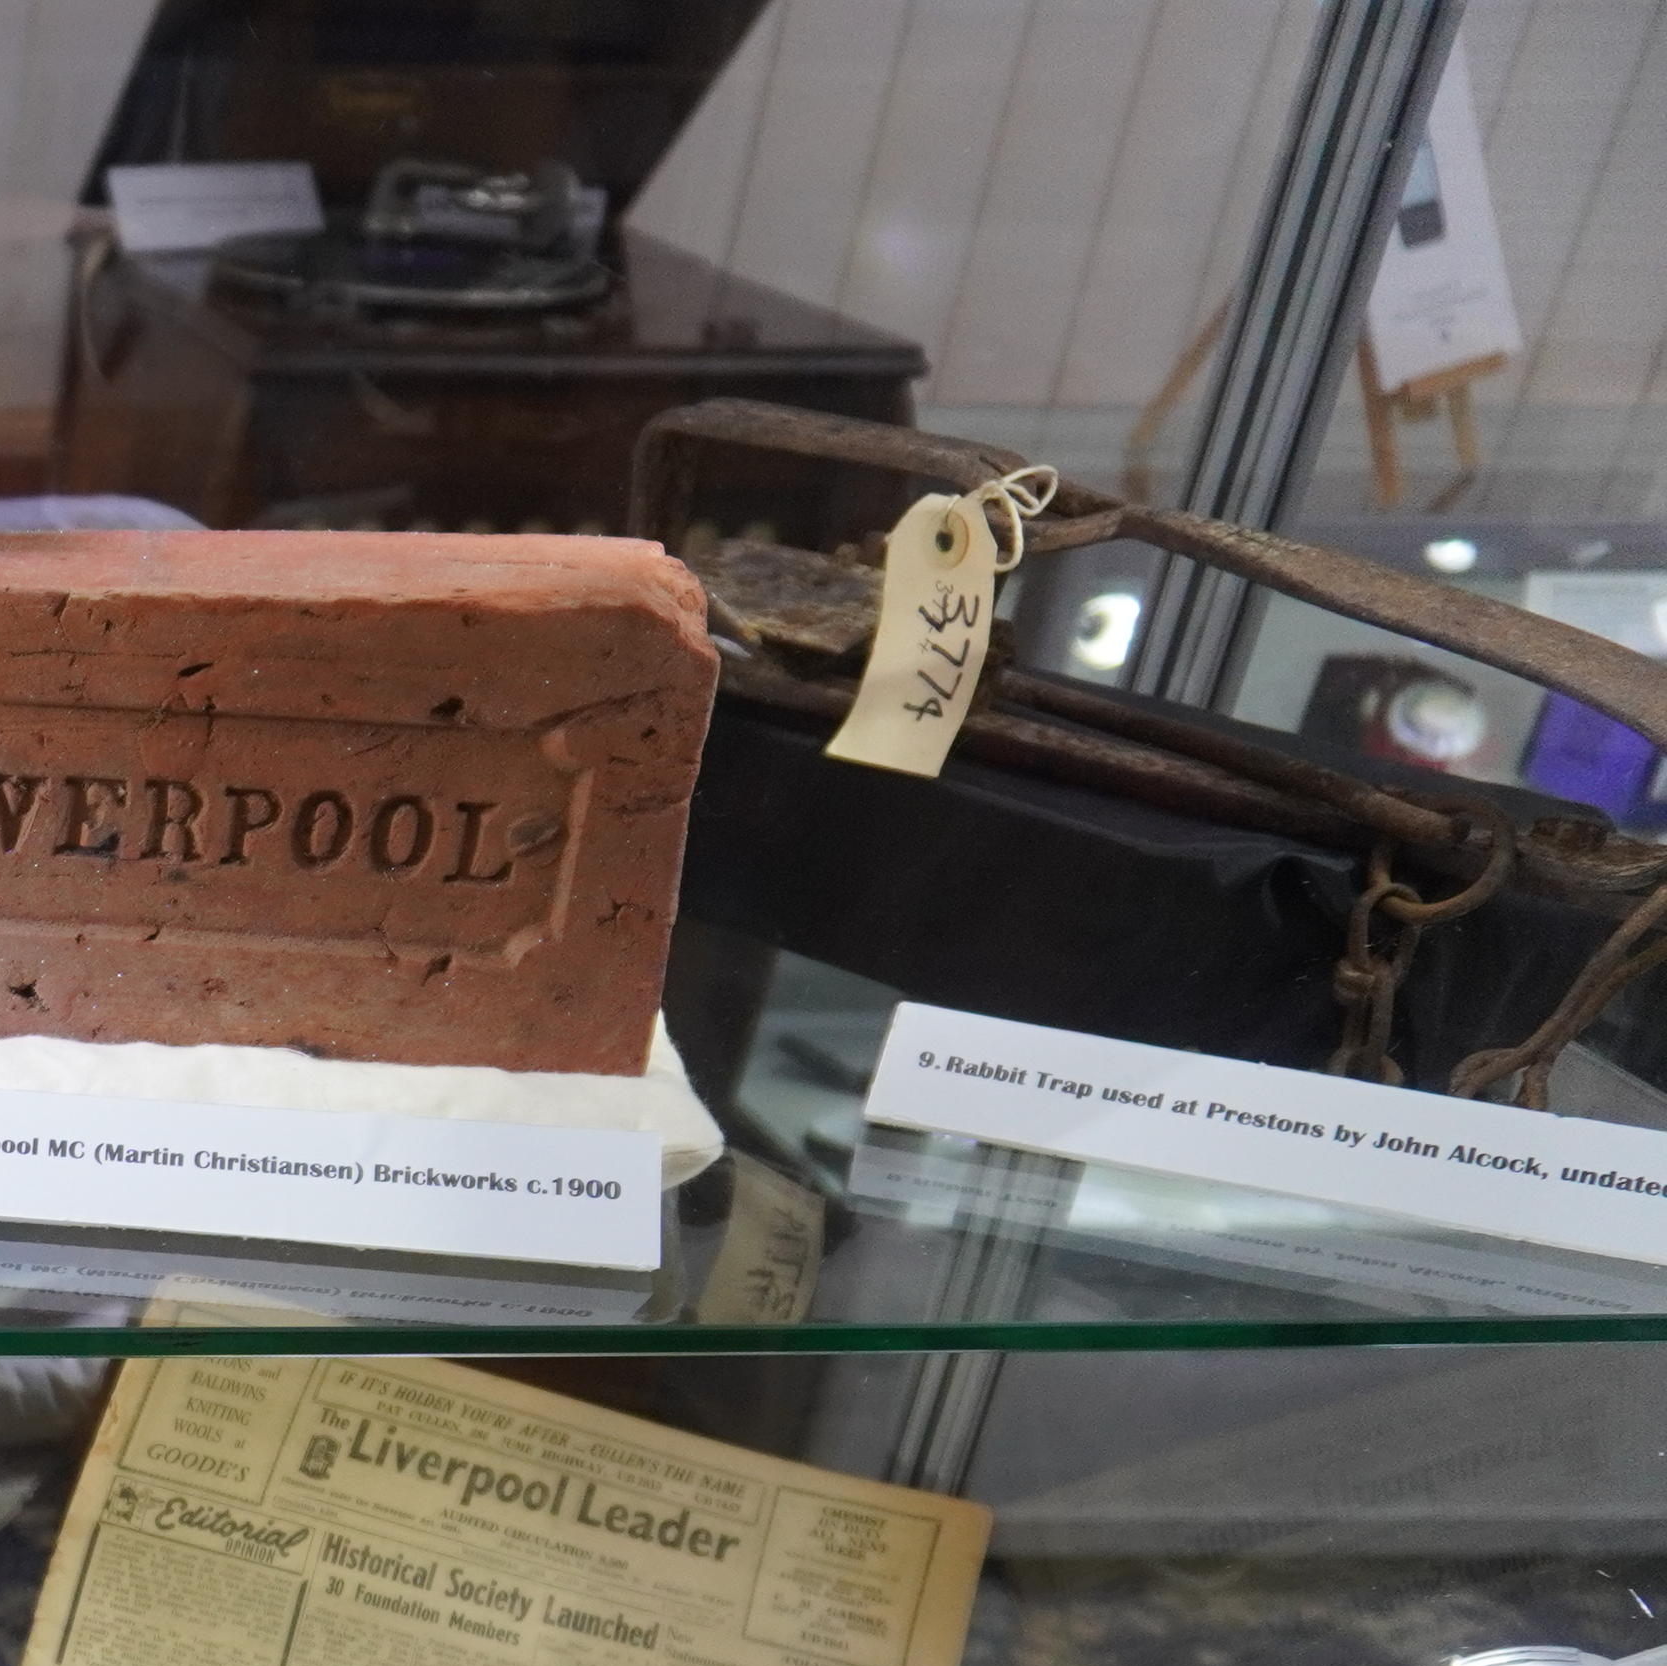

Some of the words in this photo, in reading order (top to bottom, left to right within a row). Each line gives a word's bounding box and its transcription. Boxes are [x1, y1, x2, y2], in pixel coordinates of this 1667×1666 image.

[1037, 1071, 1093, 1100] Trap
[1101, 1087, 1165, 1109] used
[1171, 1100, 1198, 1116] at
[1206, 1102, 1325, 1138] Prestons
[1333, 1124, 1367, 1148] by
[1372, 1131, 1440, 1159] John
[1447, 1144, 1549, 1180] Alcock,
[48, 1139, 85, 1160] MC
[94, 1142, 184, 1167] (Martin
[193, 1150, 364, 1185] Christiansen)
[373, 1163, 518, 1193] Brickworks
[526, 1177, 622, 1200] c.1900
[145, 1442, 252, 1483] GOODE'S
[320, 1407, 353, 1431] The
[348, 1420, 567, 1516] Liverpool
[577, 1478, 741, 1562] Leader
[154, 1498, 310, 1558] Editorial
[323, 1532, 436, 1592] Historical
[445, 1564, 534, 1622] Society
[542, 1593, 660, 1651] Launched
[325, 1576, 345, 1597] 30
[354, 1584, 443, 1626] Foundation
[448, 1611, 521, 1647] Members
